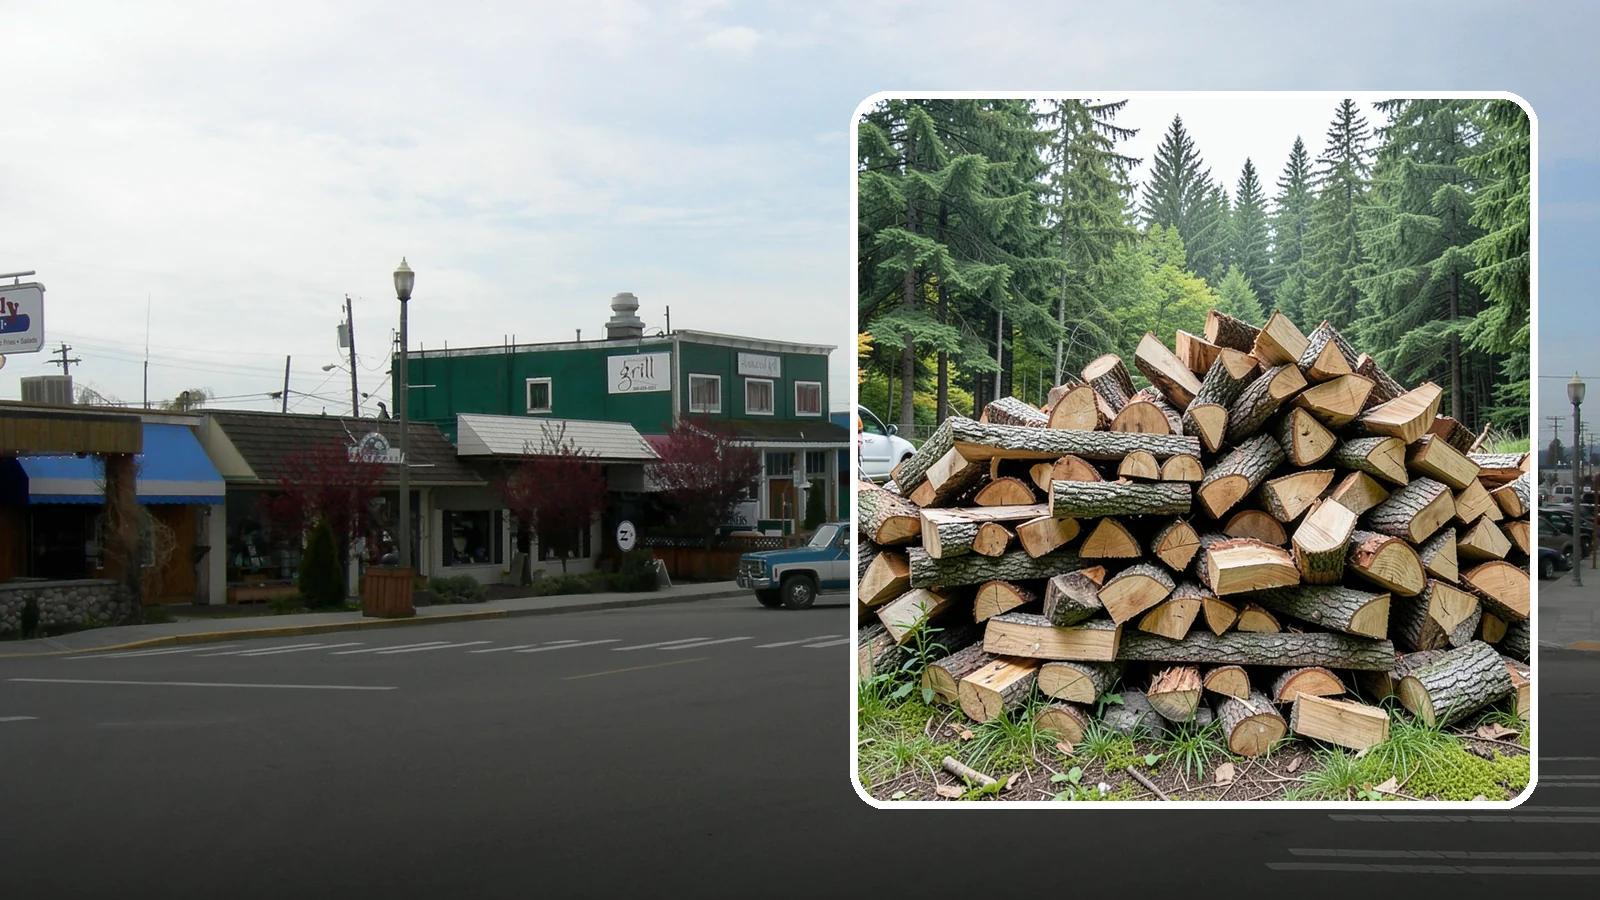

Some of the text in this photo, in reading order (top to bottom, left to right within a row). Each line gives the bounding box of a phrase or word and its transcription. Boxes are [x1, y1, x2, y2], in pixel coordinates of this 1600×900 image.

[3, 338, 16, 346] Fries
[20, 337, 38, 345] Salads
[618, 356, 655, 391] grill
